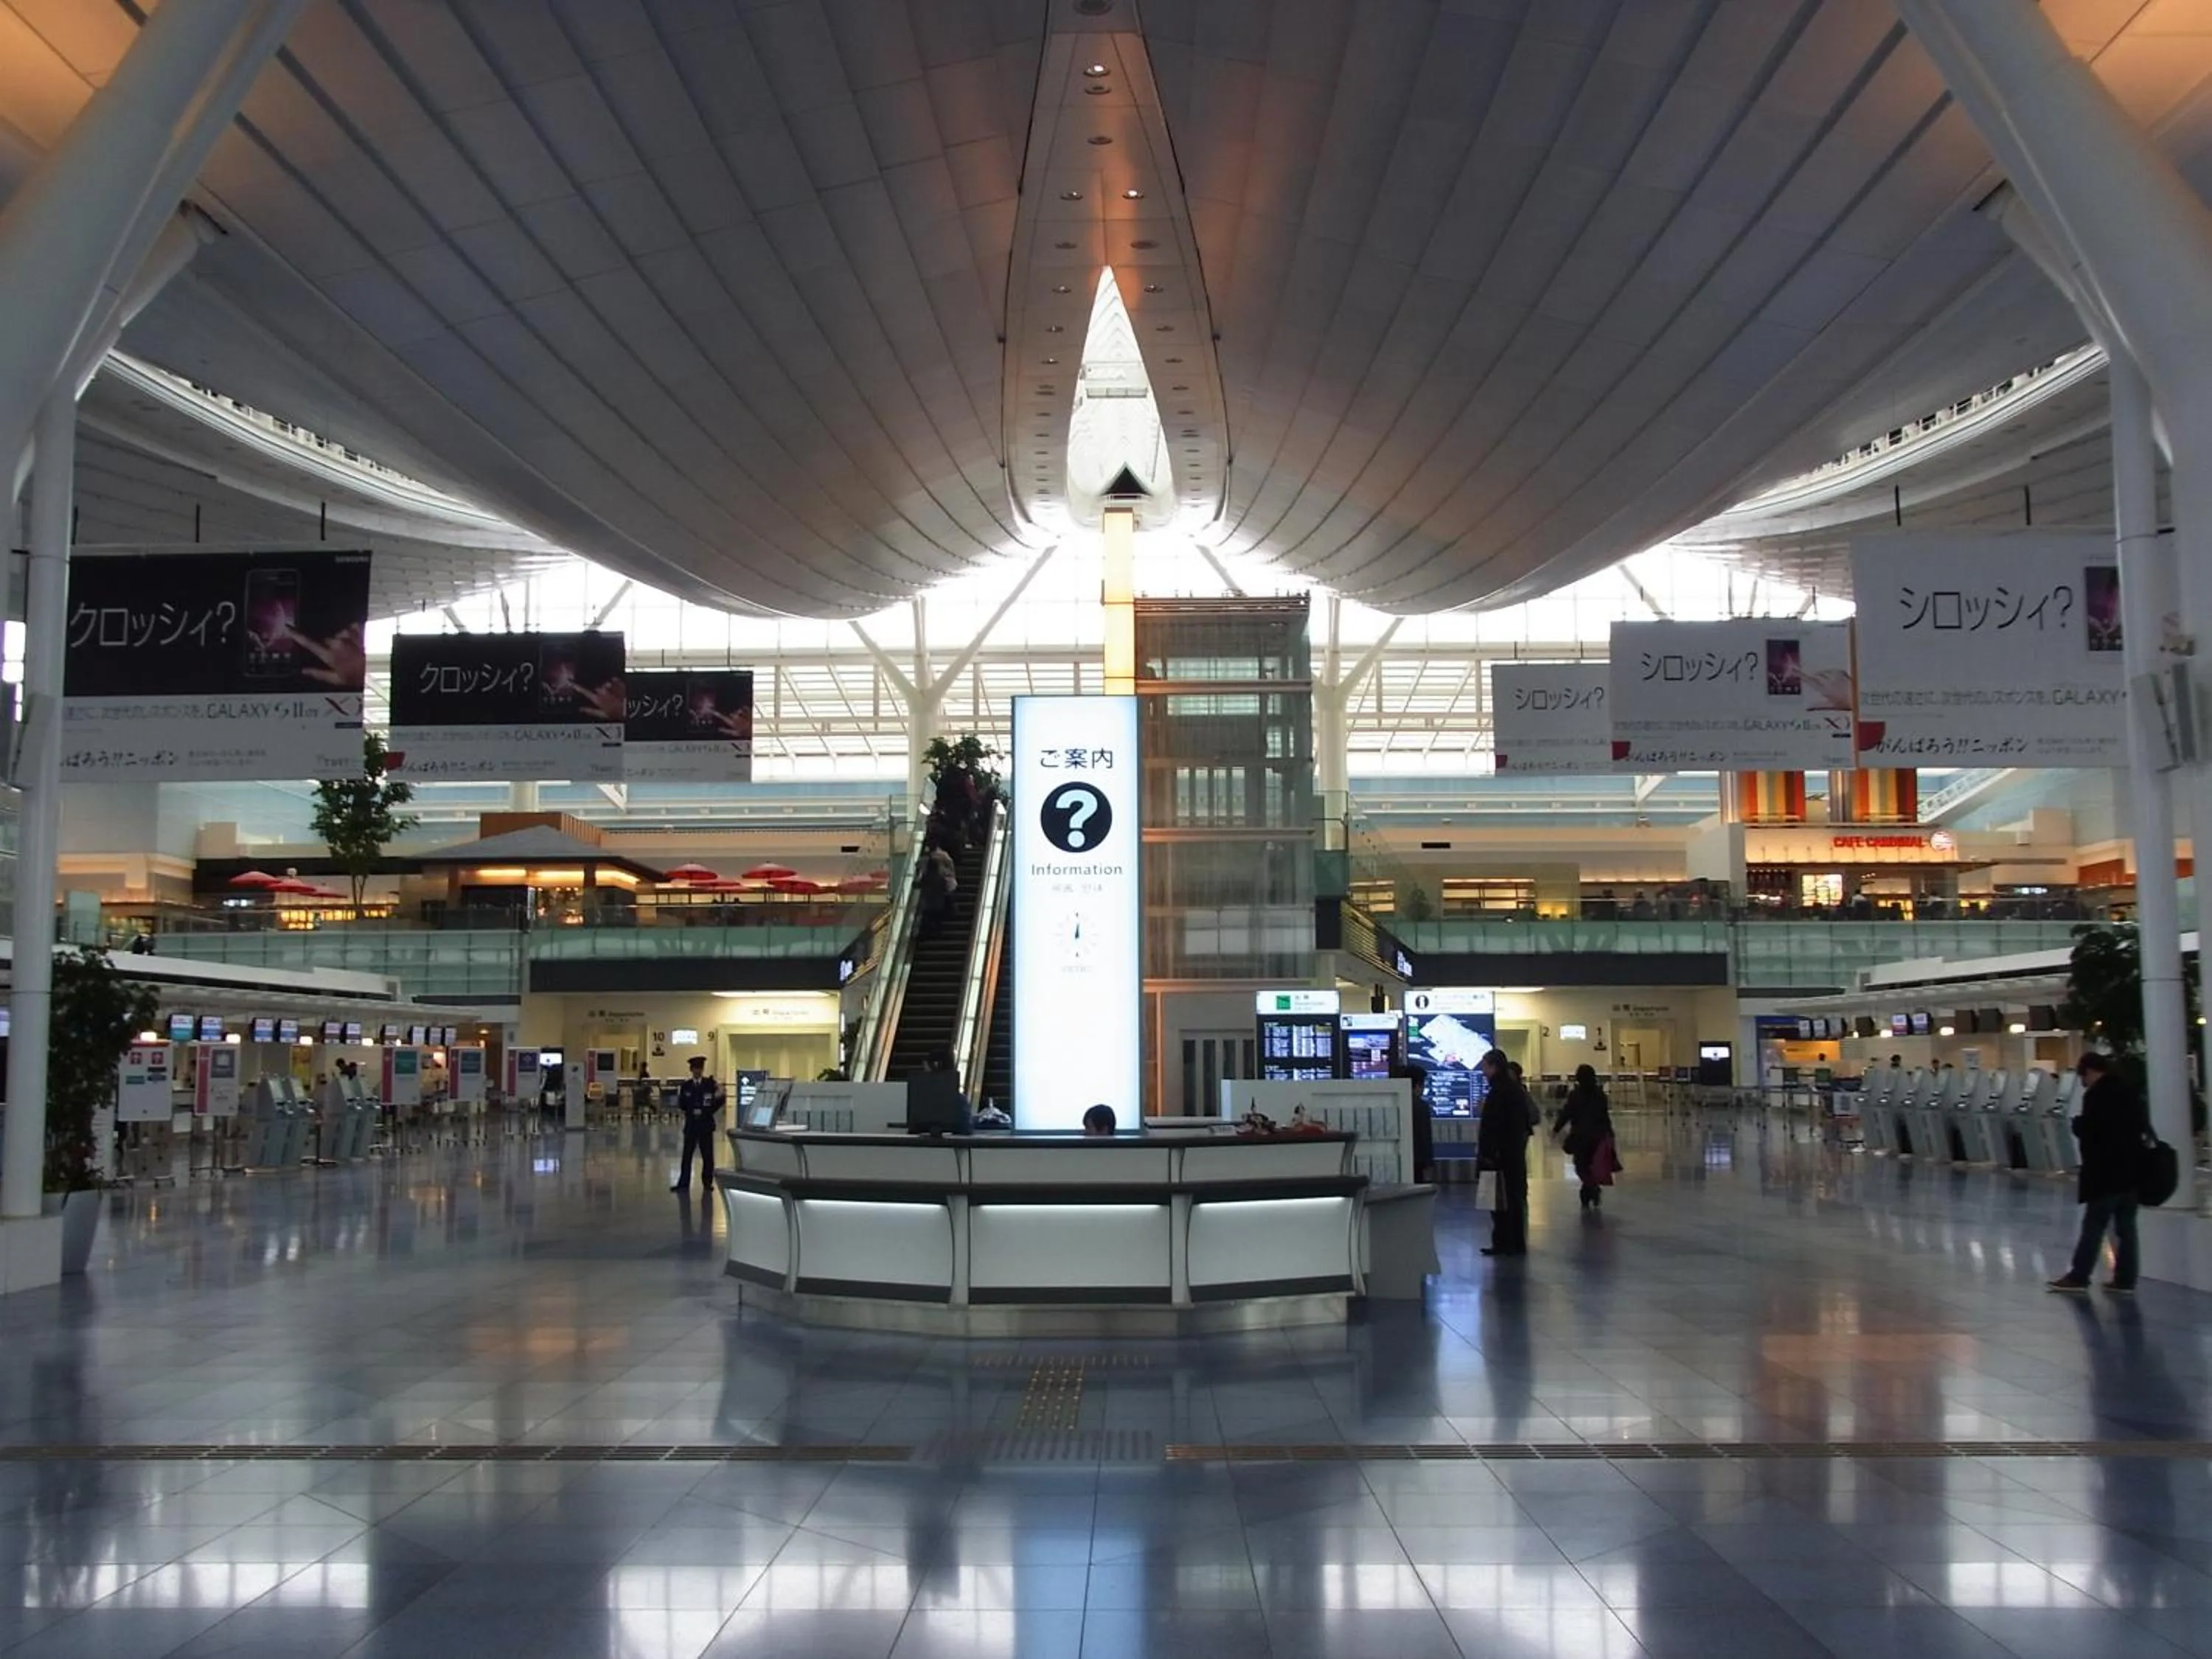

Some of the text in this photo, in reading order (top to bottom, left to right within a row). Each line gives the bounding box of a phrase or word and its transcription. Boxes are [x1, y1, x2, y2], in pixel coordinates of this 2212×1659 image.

[624, 695, 684, 719] ッシィ?
[1039, 748, 1114, 769] ご案内
[1031, 863, 1123, 876] Information
[653, 1032, 664, 1041] 10
[707, 1031, 714, 1041] 9
